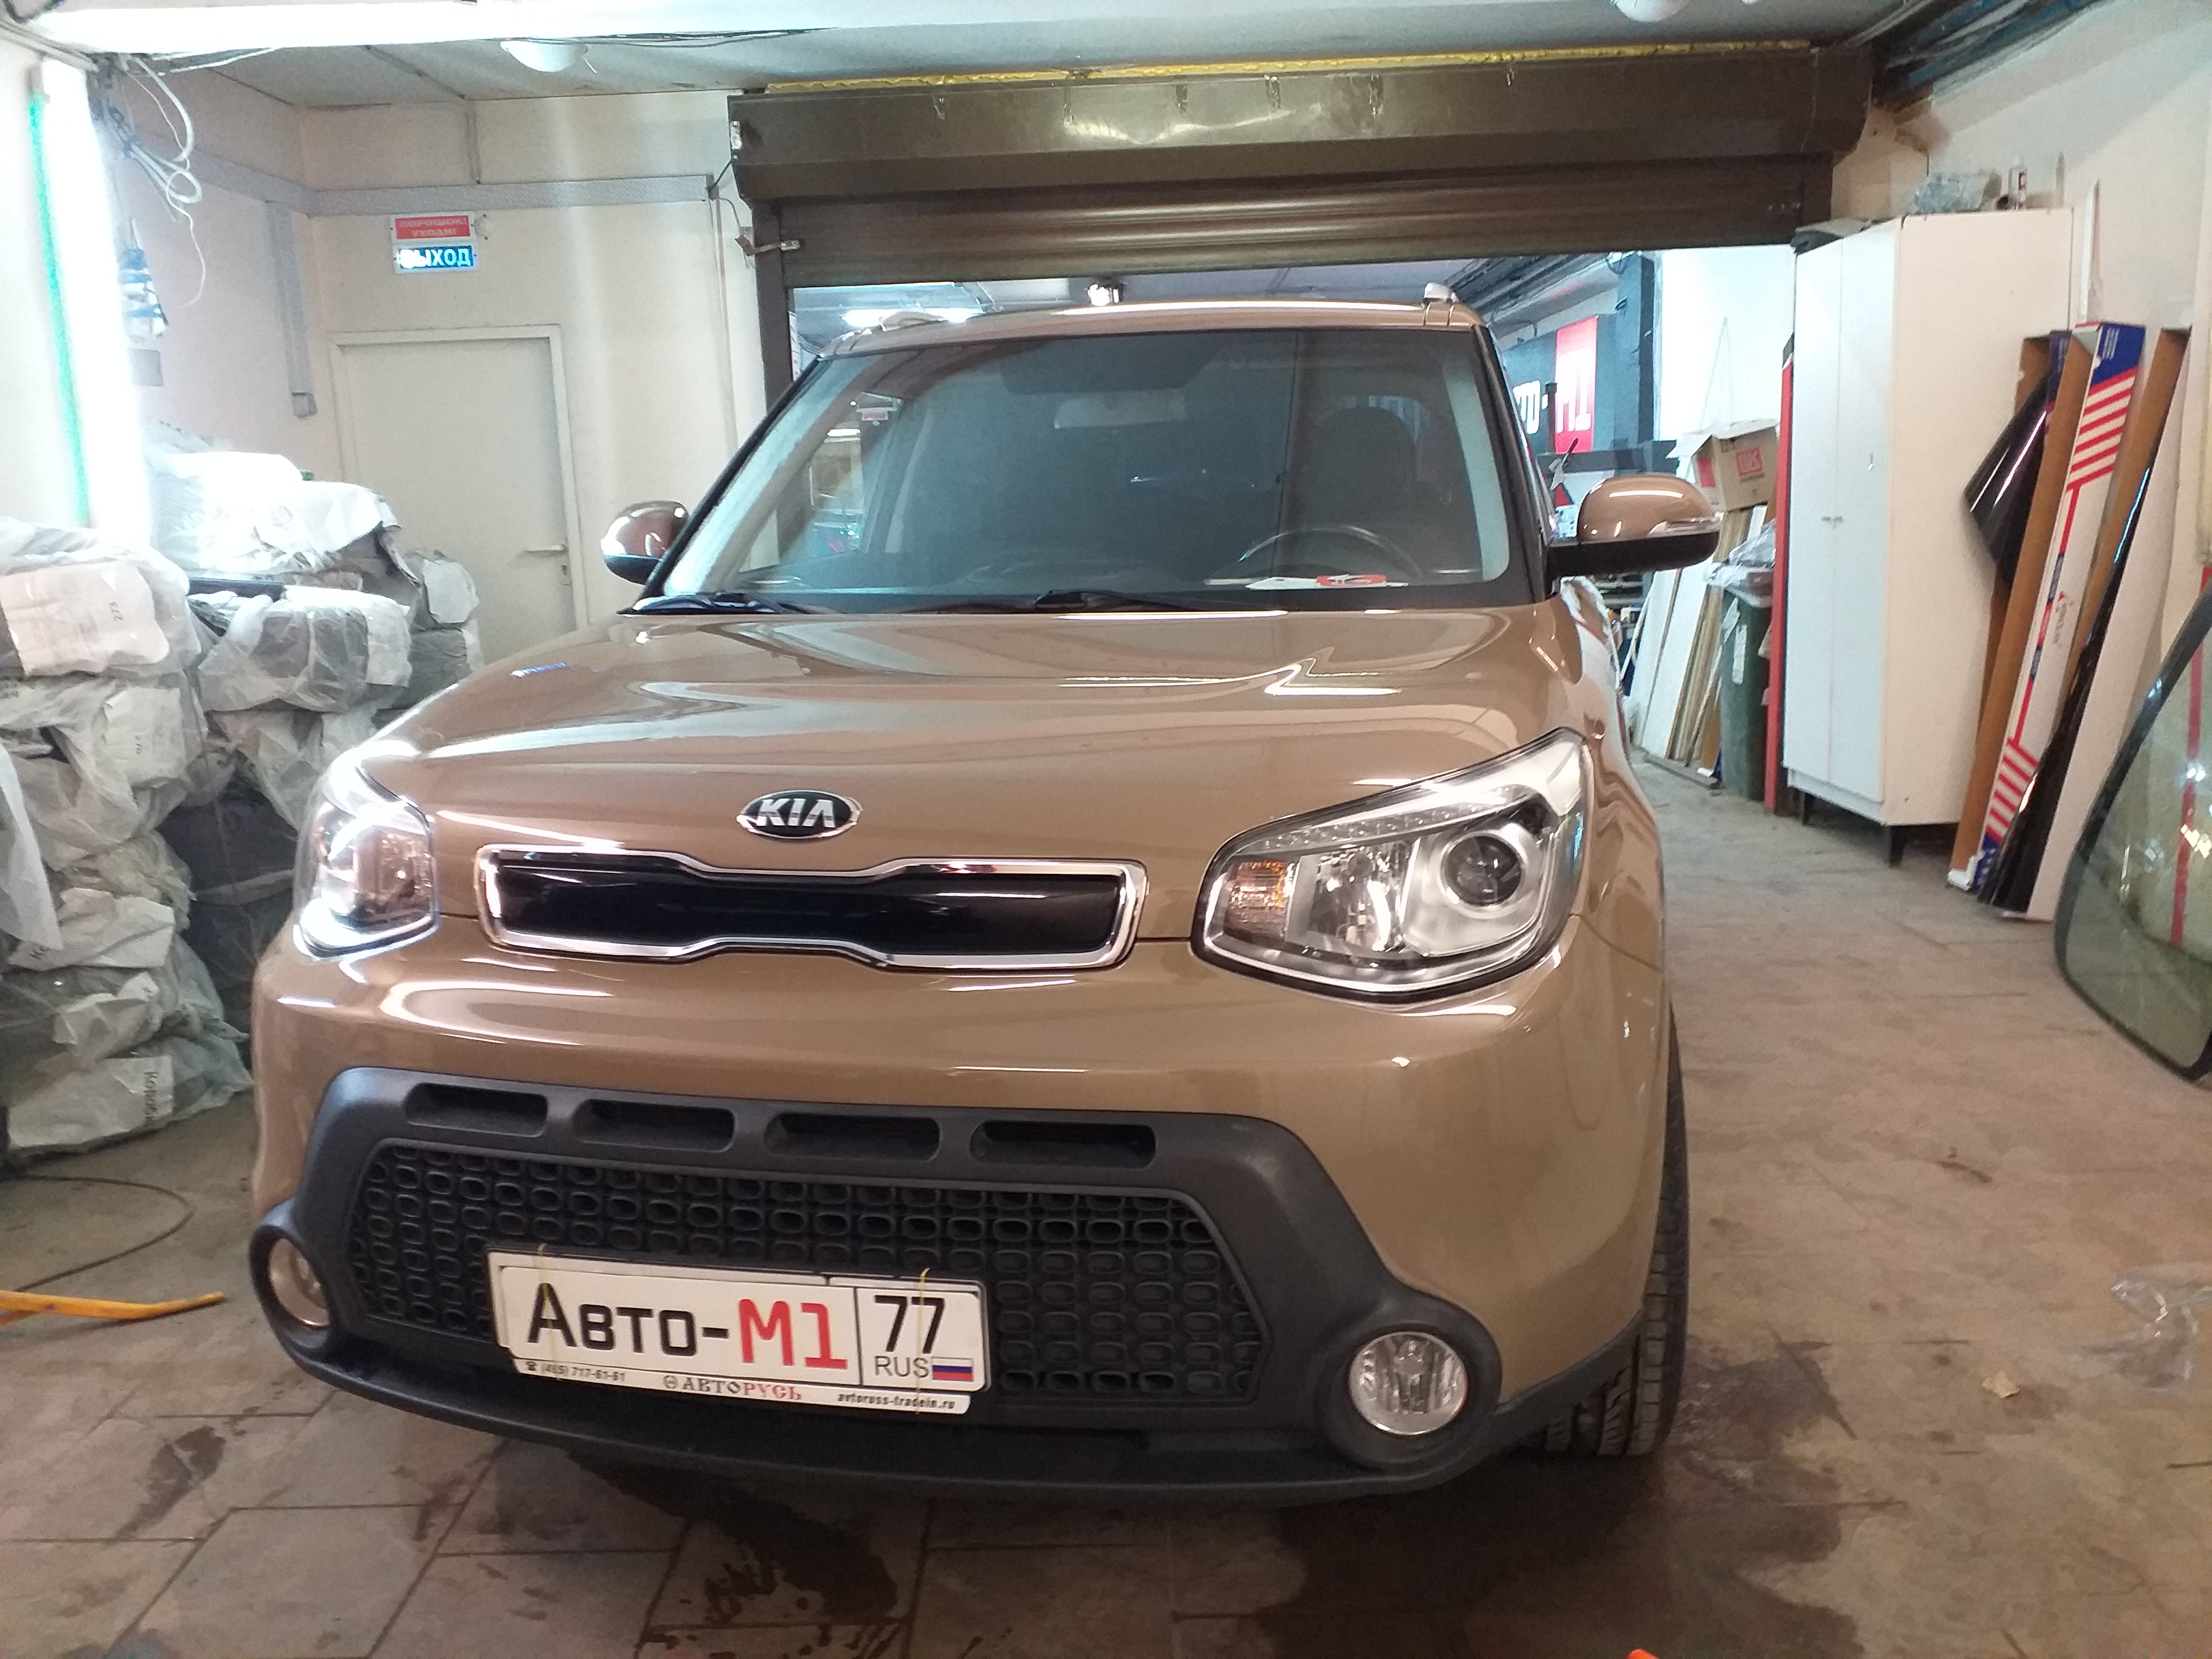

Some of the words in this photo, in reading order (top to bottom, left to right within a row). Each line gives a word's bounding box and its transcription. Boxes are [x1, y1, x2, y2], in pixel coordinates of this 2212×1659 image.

[757, 797, 836, 828] KIA
[873, 1295, 946, 1355] 77
[875, 1355, 930, 1378] RUS
[682, 1377, 802, 1400] АВТОРУСЬ
